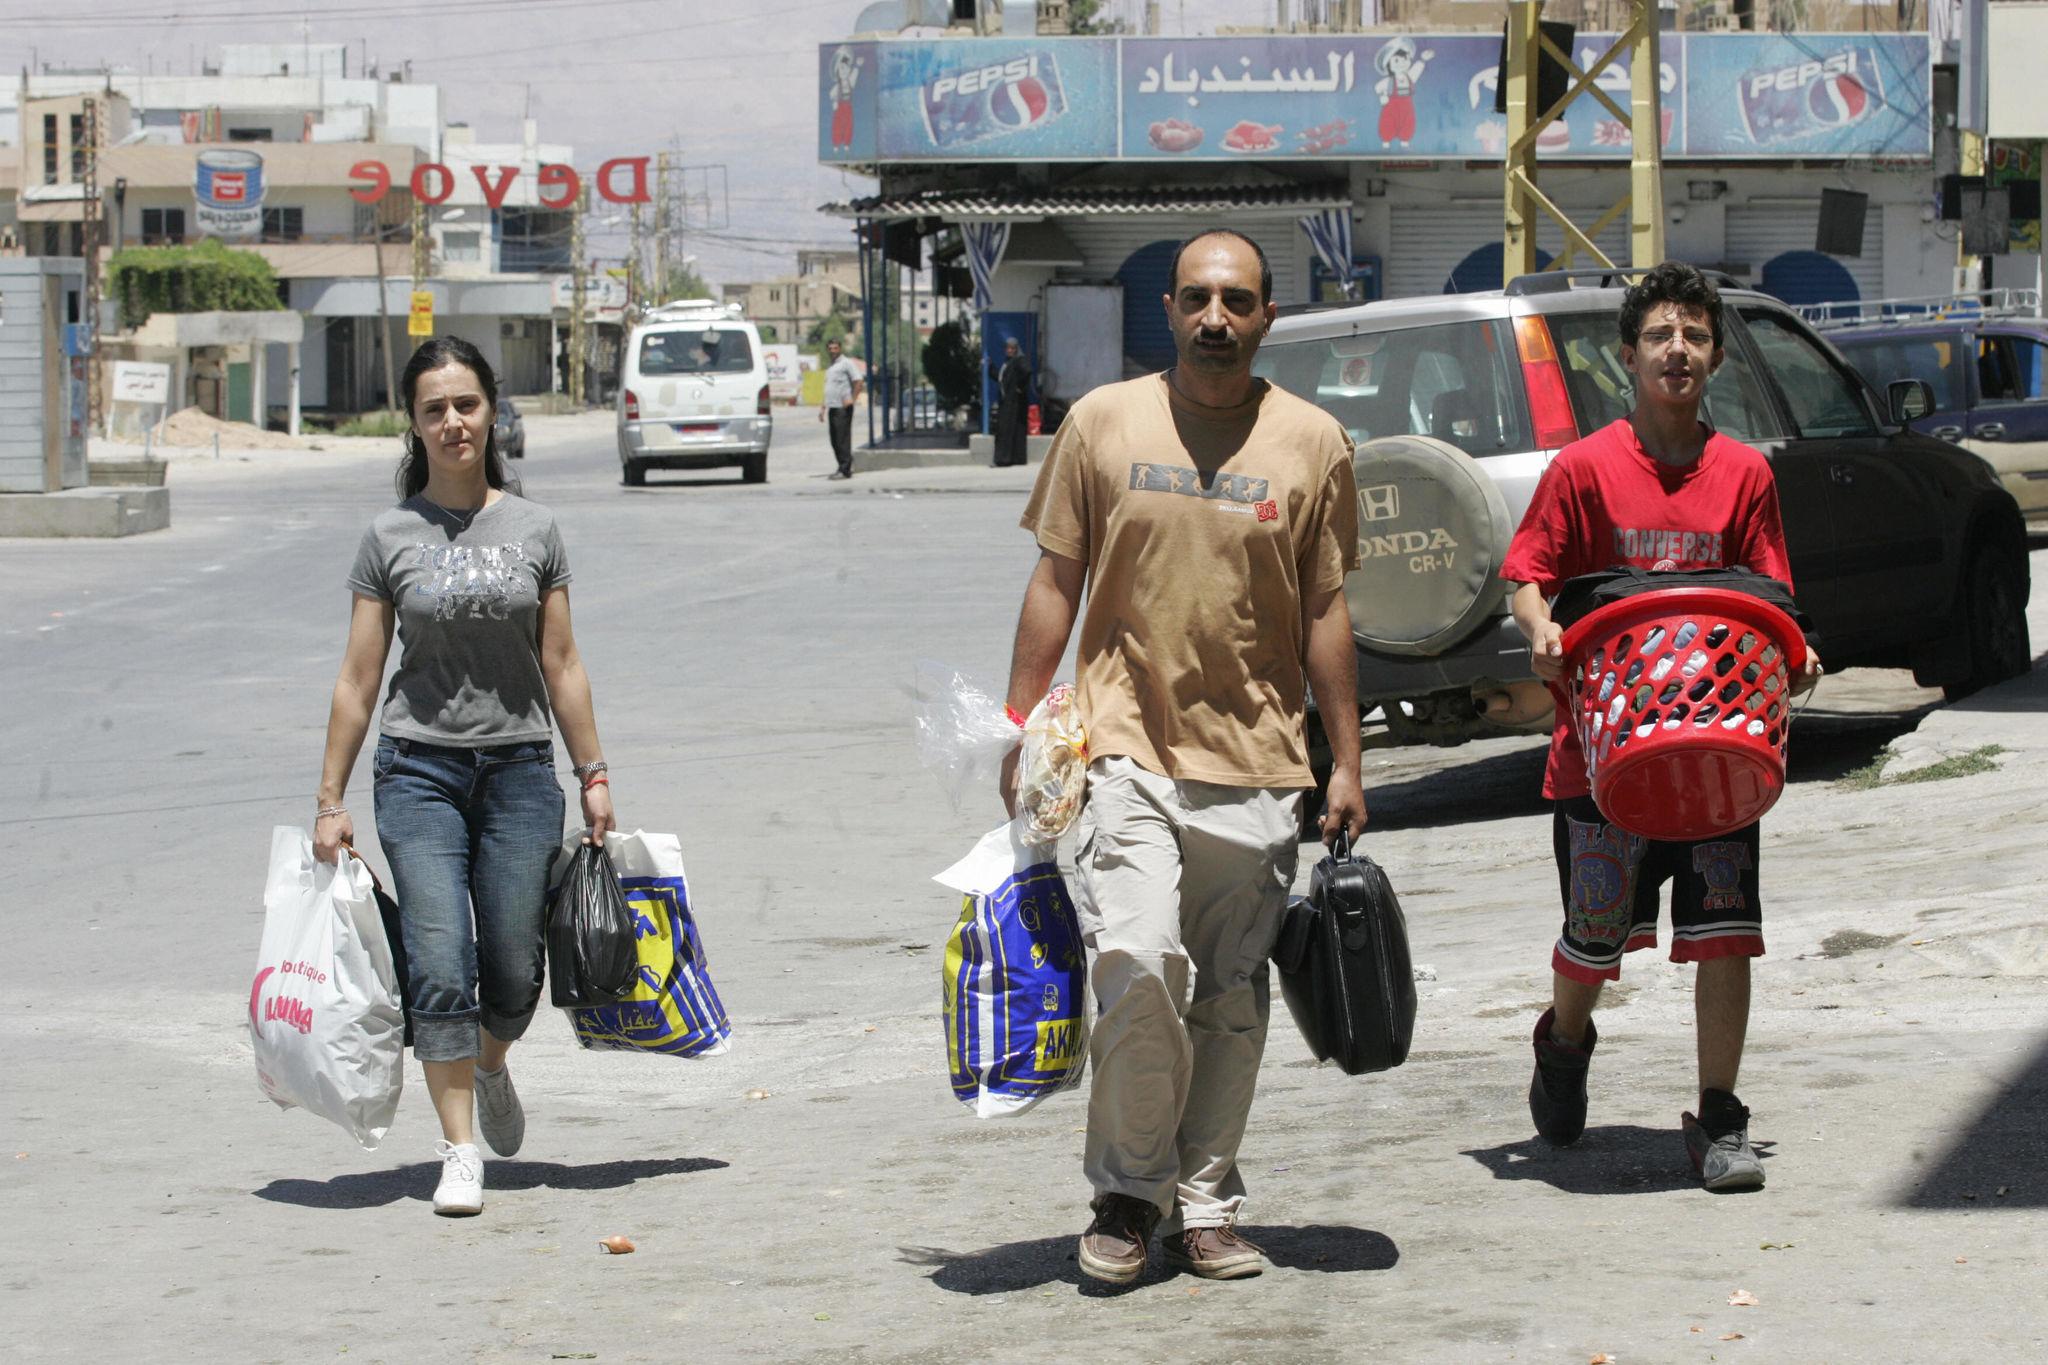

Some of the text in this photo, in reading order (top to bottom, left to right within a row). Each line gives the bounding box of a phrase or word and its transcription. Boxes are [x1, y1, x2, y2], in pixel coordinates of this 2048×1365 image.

[932, 56, 1039, 102] PEPSI
[1138, 50, 1355, 107] السندباد
[1750, 51, 1857, 99] PEPSI
[1358, 527, 1459, 560] ONDA
[1409, 552, 1455, 573] CR-V
[1613, 527, 1723, 562] CONVERSE
